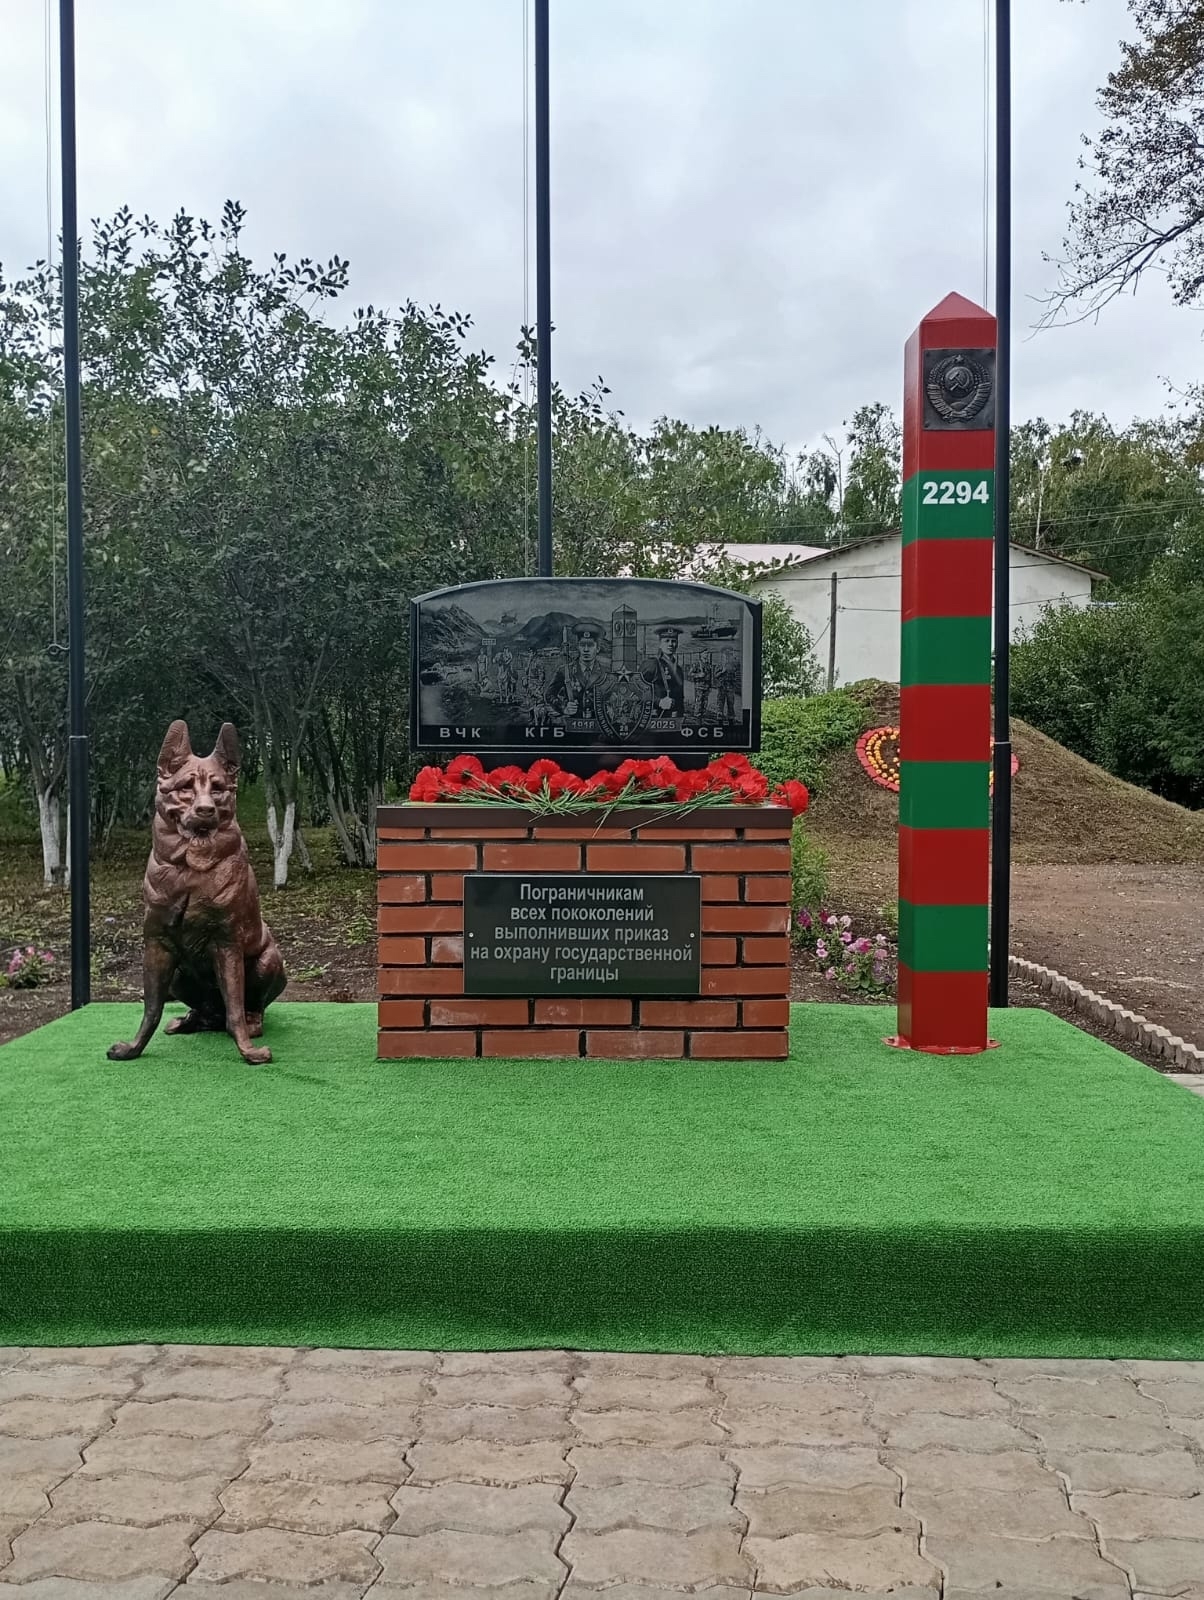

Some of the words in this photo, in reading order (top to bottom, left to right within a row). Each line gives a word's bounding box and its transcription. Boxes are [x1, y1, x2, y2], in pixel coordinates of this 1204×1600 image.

[922, 481, 990, 505] 2294
[439, 726, 481, 738] ВЧК
[525, 726, 566, 738] КГБ
[650, 720, 676, 729] 2025
[680, 726, 724, 738] ФСБ
[520, 883, 644, 903] Пограничникам
[510, 907, 547, 920] всех
[551, 904, 655, 921] пококолений
[494, 926, 610, 941] выполнивших
[615, 928, 669, 944] приказ
[470, 946, 489, 960] на
[494, 946, 550, 963] охрану
[555, 944, 692, 964] государственной
[550, 967, 619, 983] границы
